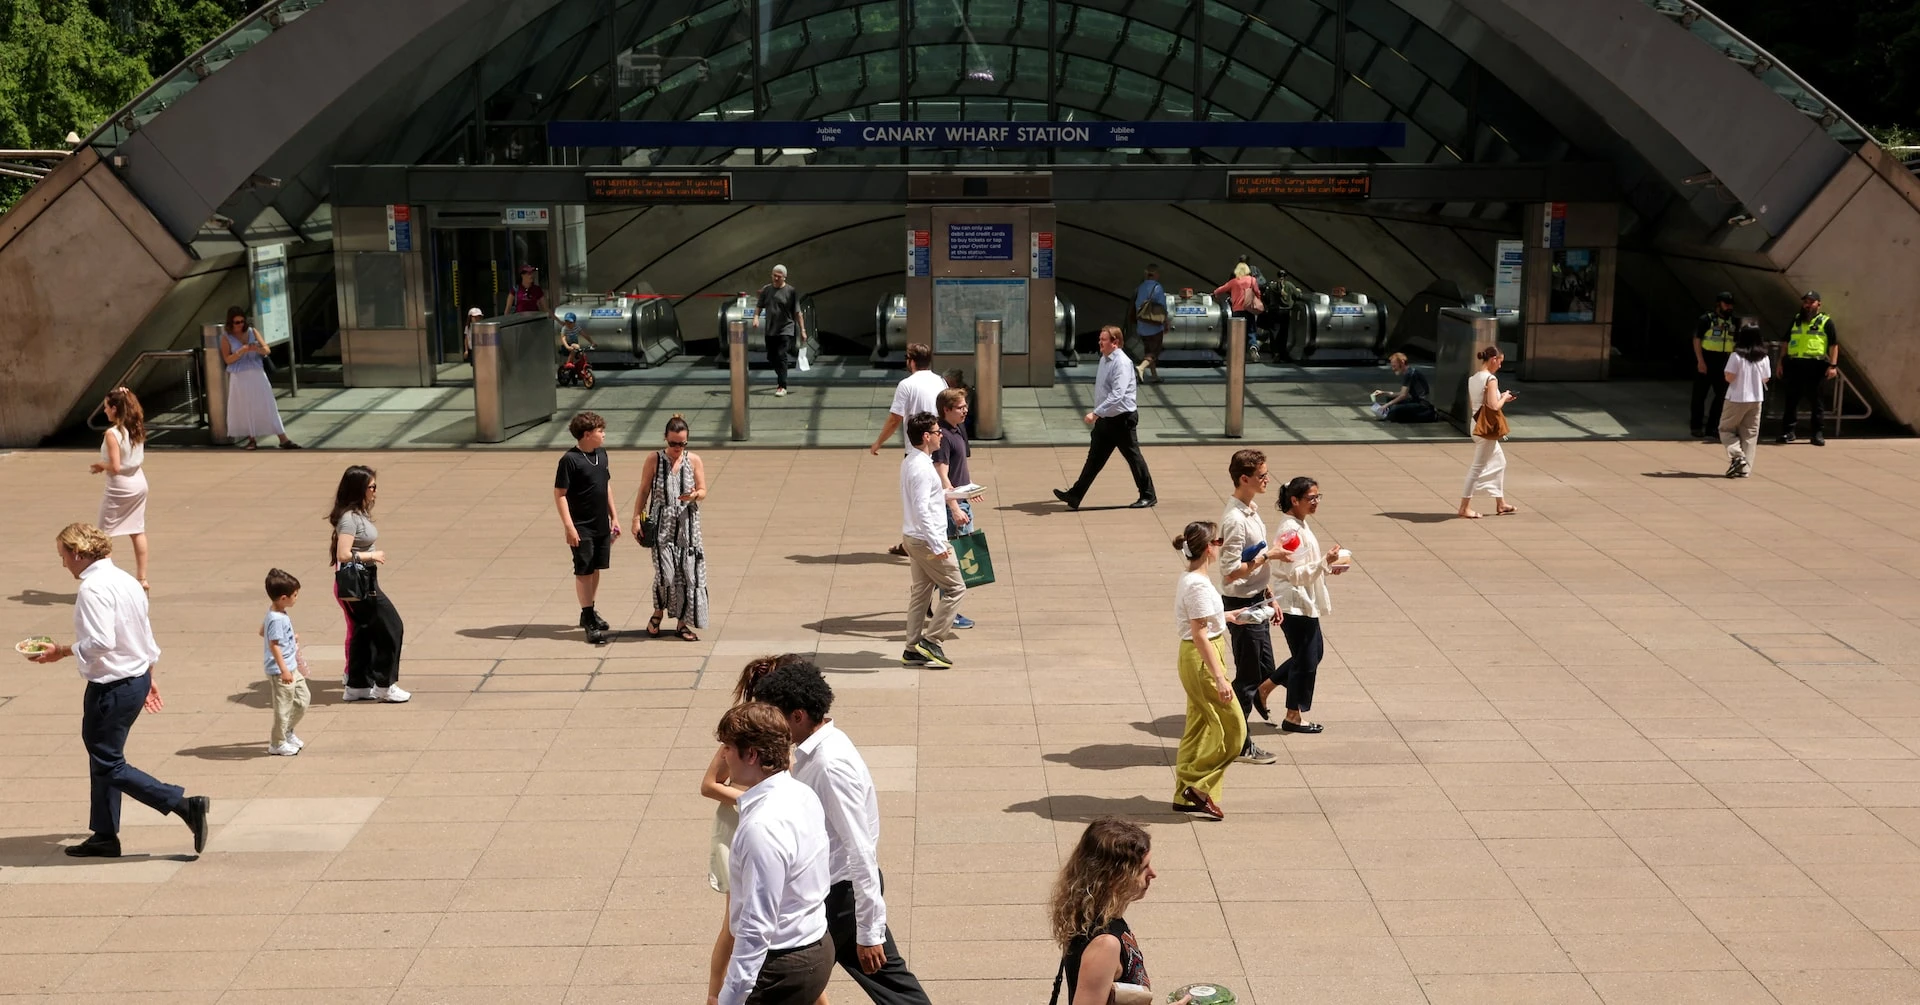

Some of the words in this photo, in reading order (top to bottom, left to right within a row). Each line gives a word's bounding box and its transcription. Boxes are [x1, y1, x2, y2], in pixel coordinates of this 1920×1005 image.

[816, 127, 842, 135] Jubilee
[862, 126, 936, 142] CANARY
[945, 126, 1009, 142] WHARF
[1017, 126, 1090, 142] STATION
[1109, 126, 1135, 135] Jubilee
[822, 134, 836, 143] line
[1115, 134, 1129, 143] line
[1284, 178, 1305, 187] Carry
[1337, 178, 1350, 187] you
[1331, 186, 1346, 194] help
